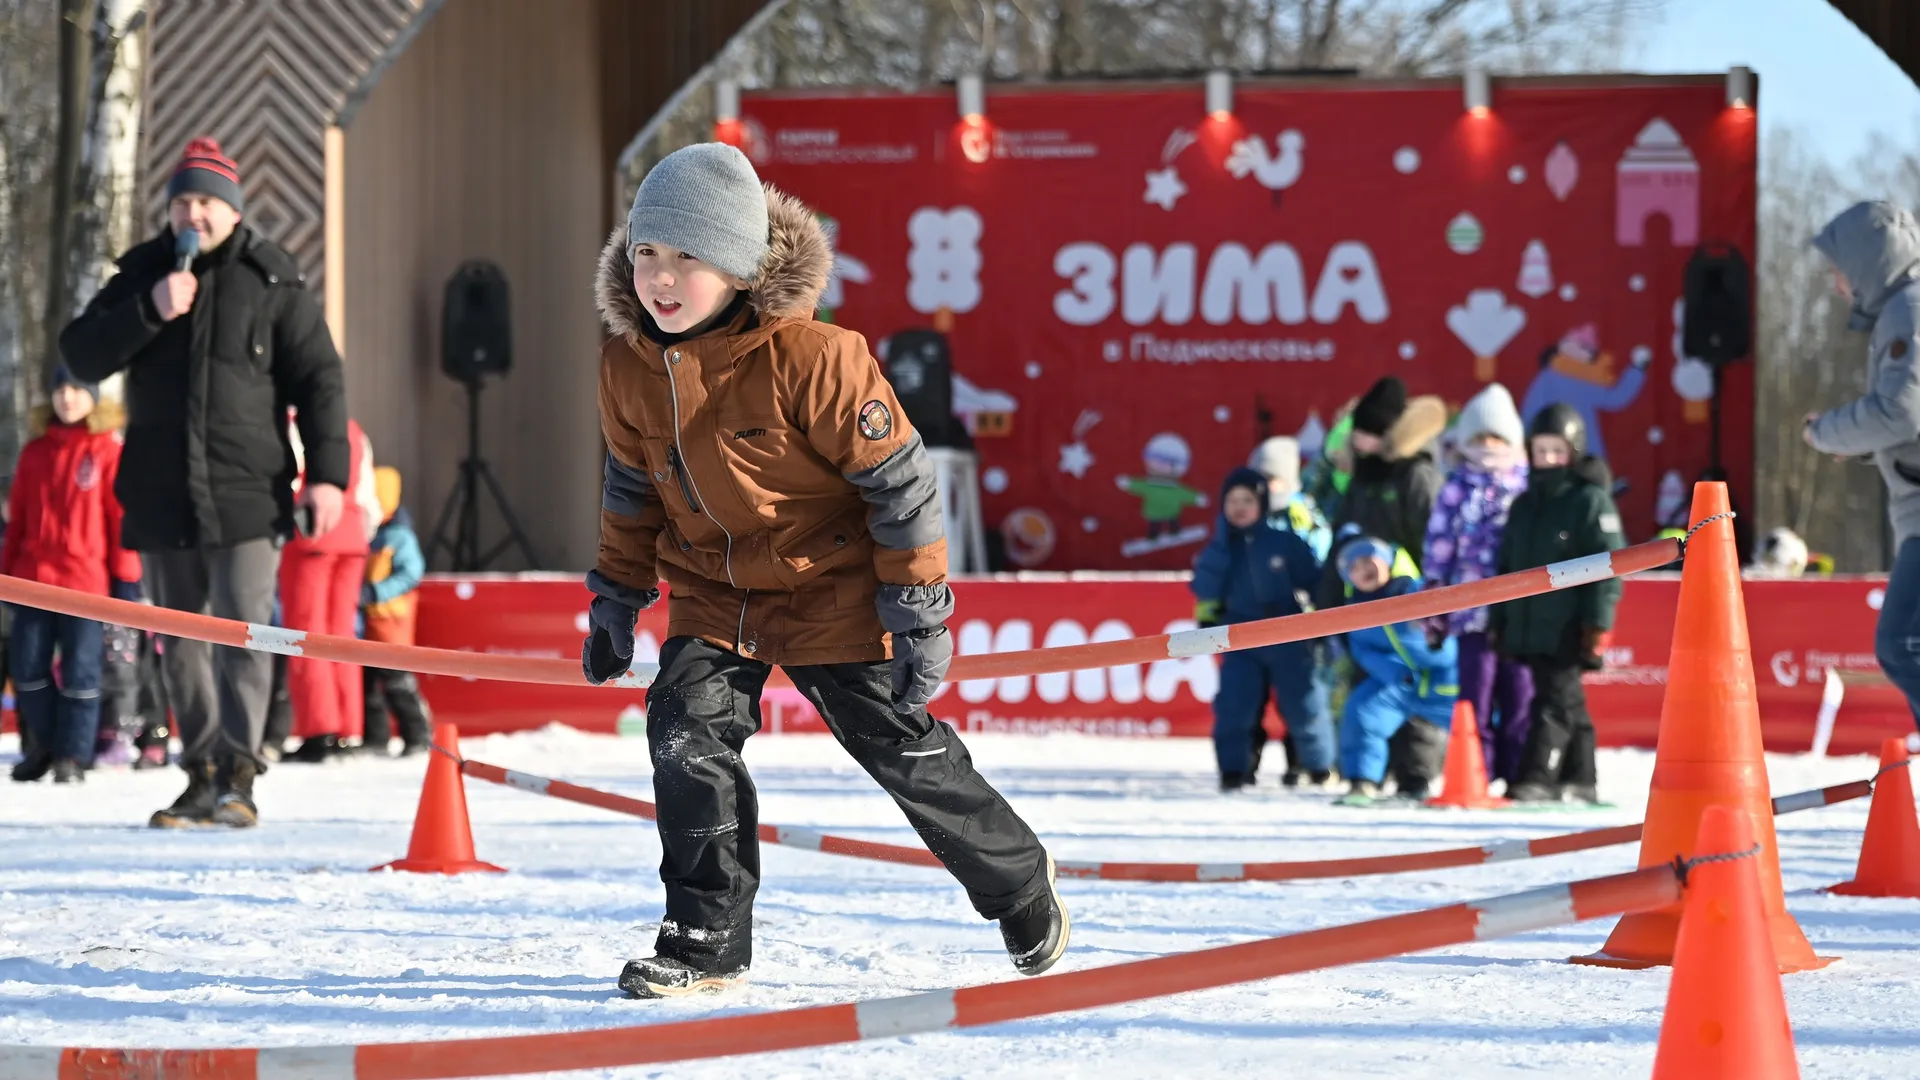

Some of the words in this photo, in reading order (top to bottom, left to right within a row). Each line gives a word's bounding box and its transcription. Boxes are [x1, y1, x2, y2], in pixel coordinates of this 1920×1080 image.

[1053, 241, 1390, 325] ЗИМА
[1129, 333, 1334, 363] Подмосковье
[930, 619, 1220, 703] ИМА
